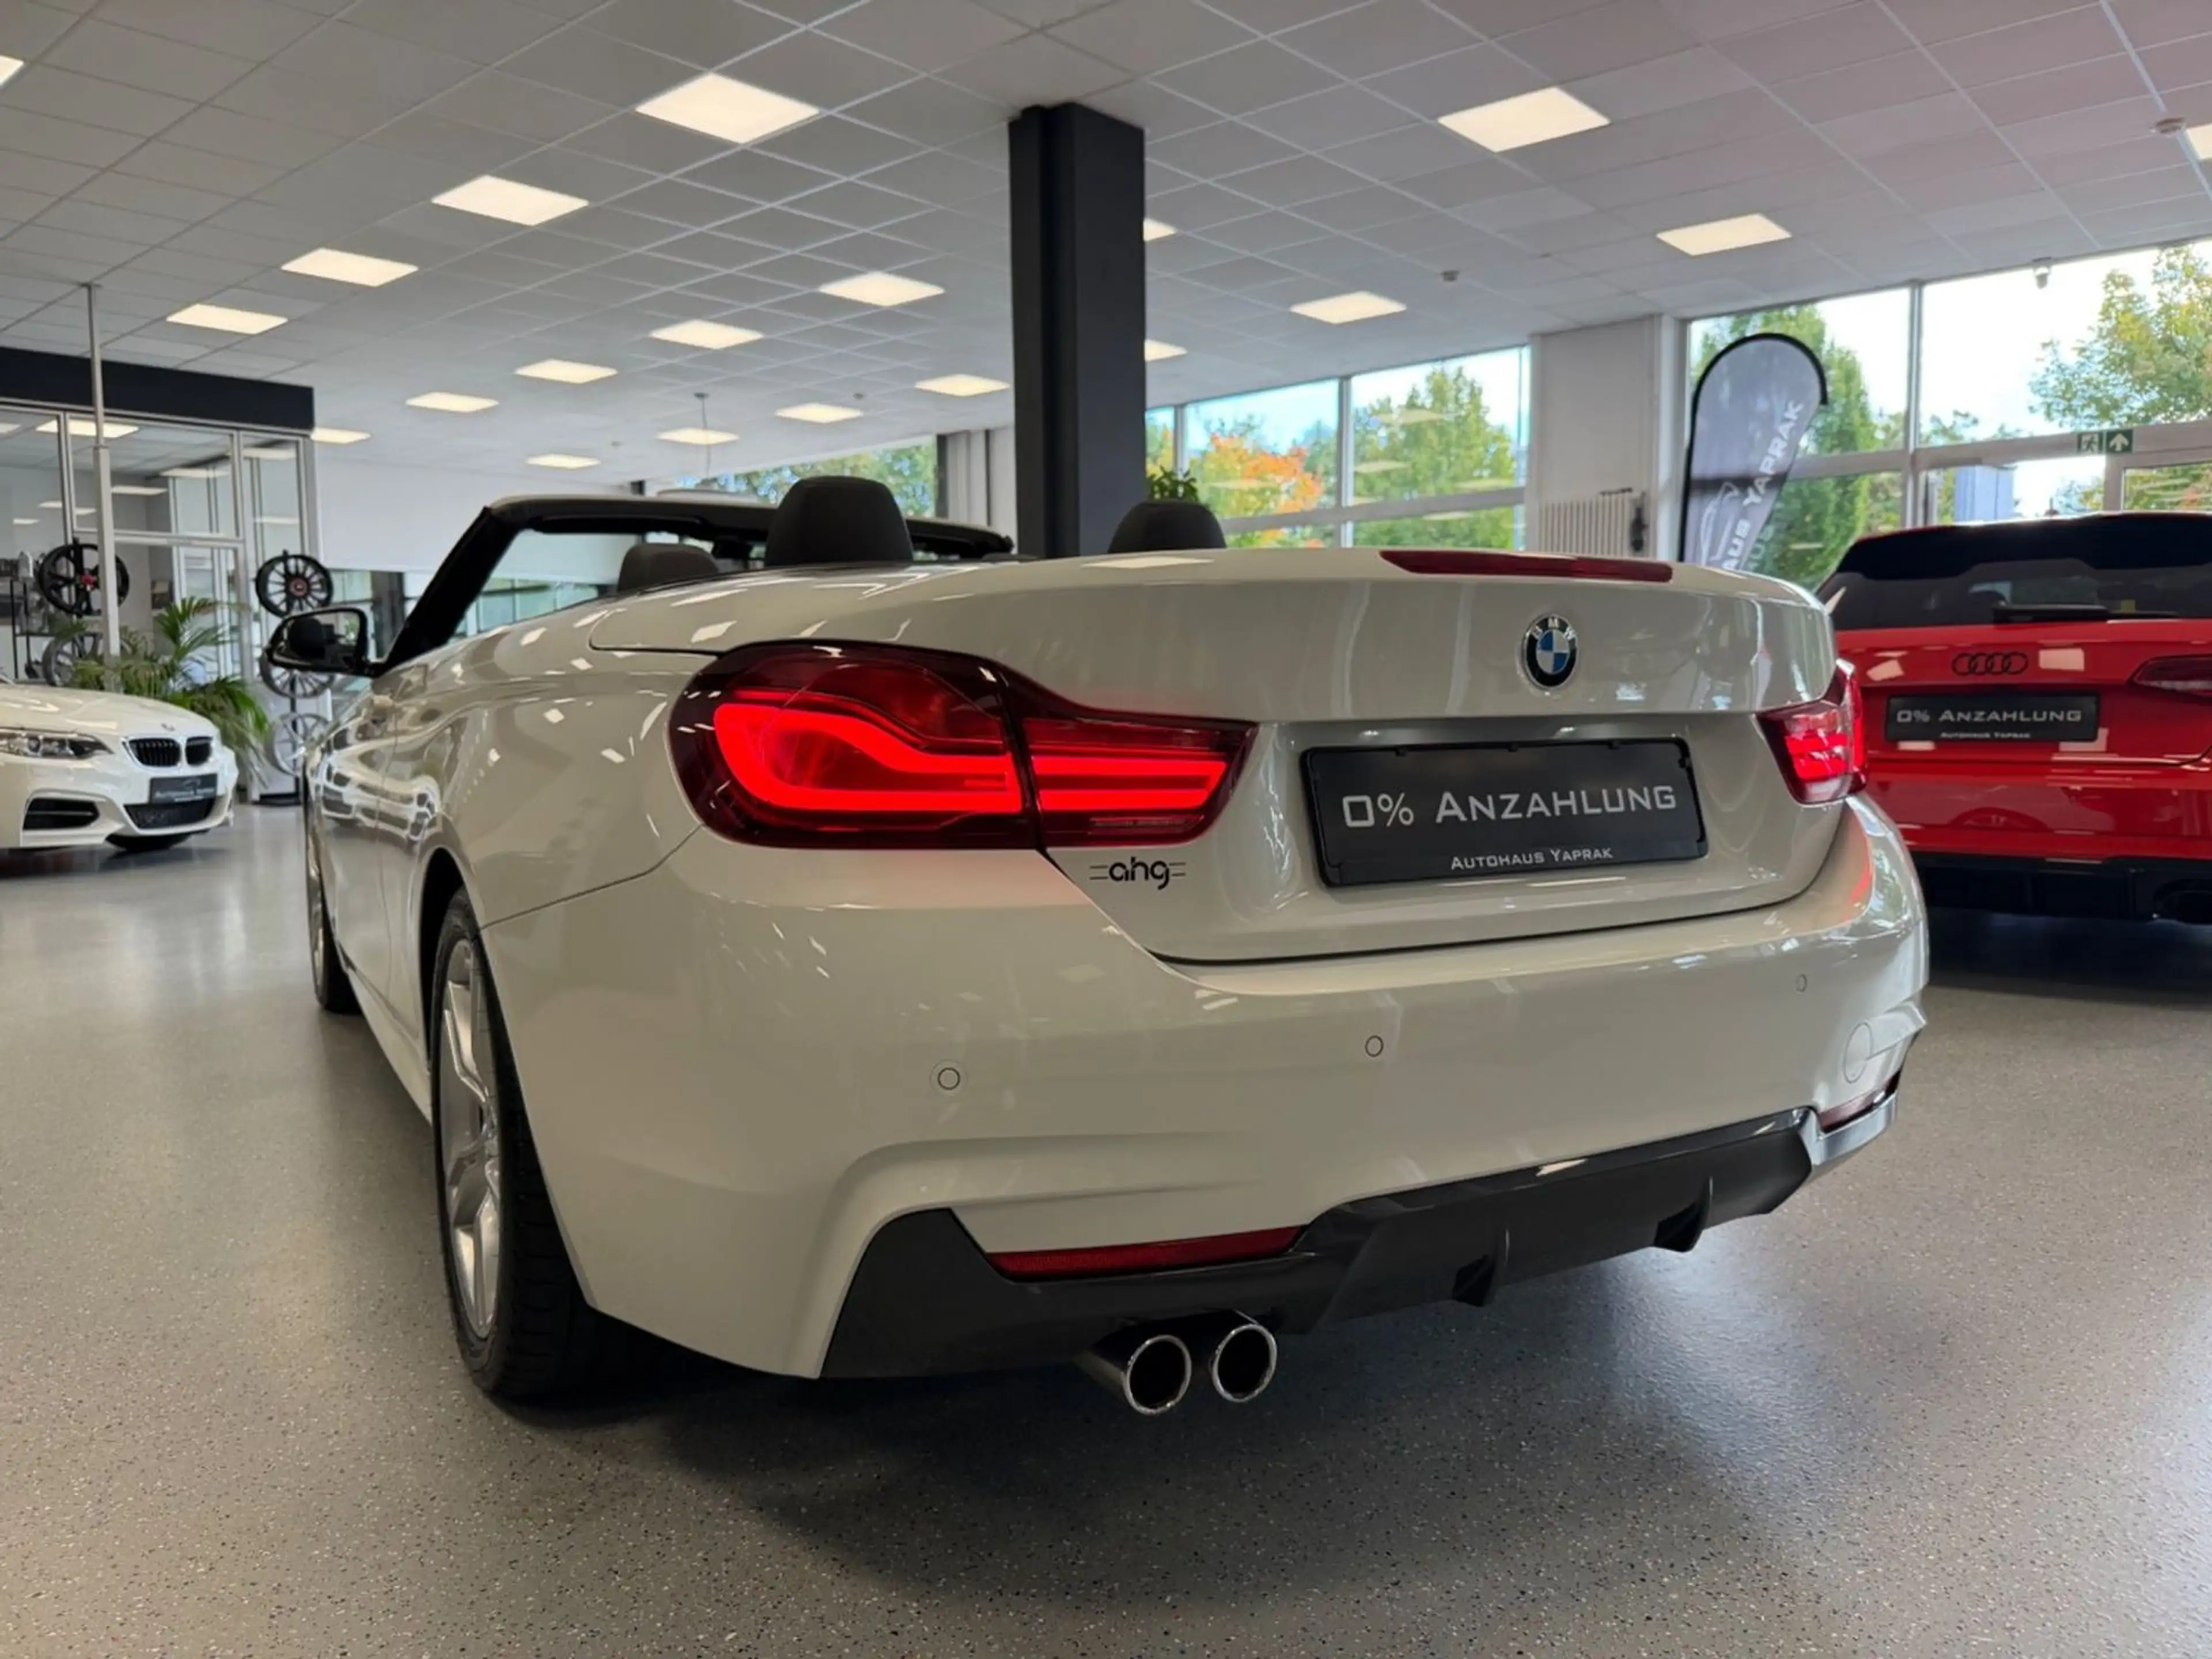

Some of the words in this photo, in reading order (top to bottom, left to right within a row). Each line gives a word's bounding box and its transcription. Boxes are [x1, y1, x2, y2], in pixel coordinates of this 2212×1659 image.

[1532, 616, 1577, 641] BMW
[1897, 709, 1930, 723] 0%
[1938, 710, 2081, 722] ANZAHLUNG
[1342, 793, 1414, 827] 0%
[1436, 785, 1676, 823] ANZAHLUNG
[1451, 851, 1544, 870] AUTOHAUS
[1550, 847, 1613, 862] YAPRAK
[1109, 856, 1169, 890] ahg
